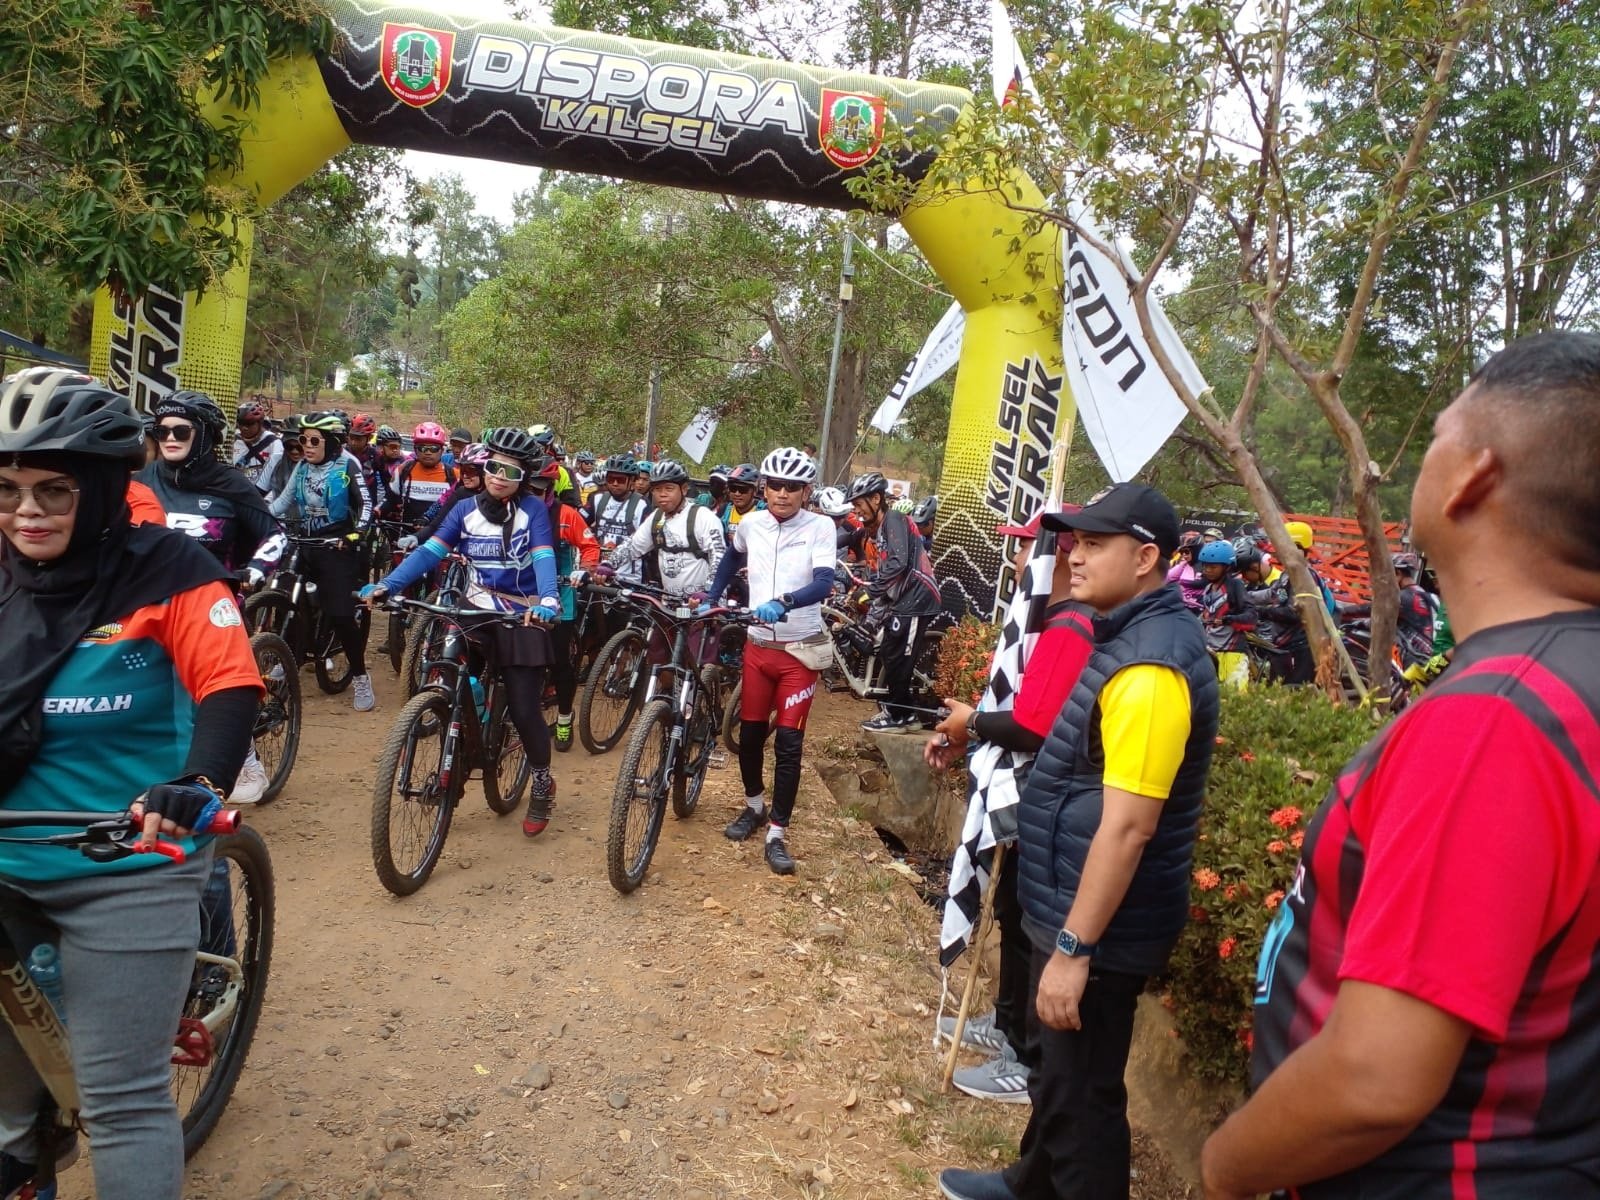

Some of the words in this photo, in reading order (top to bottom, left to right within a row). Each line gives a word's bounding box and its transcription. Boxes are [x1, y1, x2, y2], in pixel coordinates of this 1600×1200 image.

[465, 35, 806, 136] DISPORA
[543, 98, 727, 154] KALSEL
[985, 355, 1031, 516] KALSEL
[42, 694, 132, 714] ERKAH
